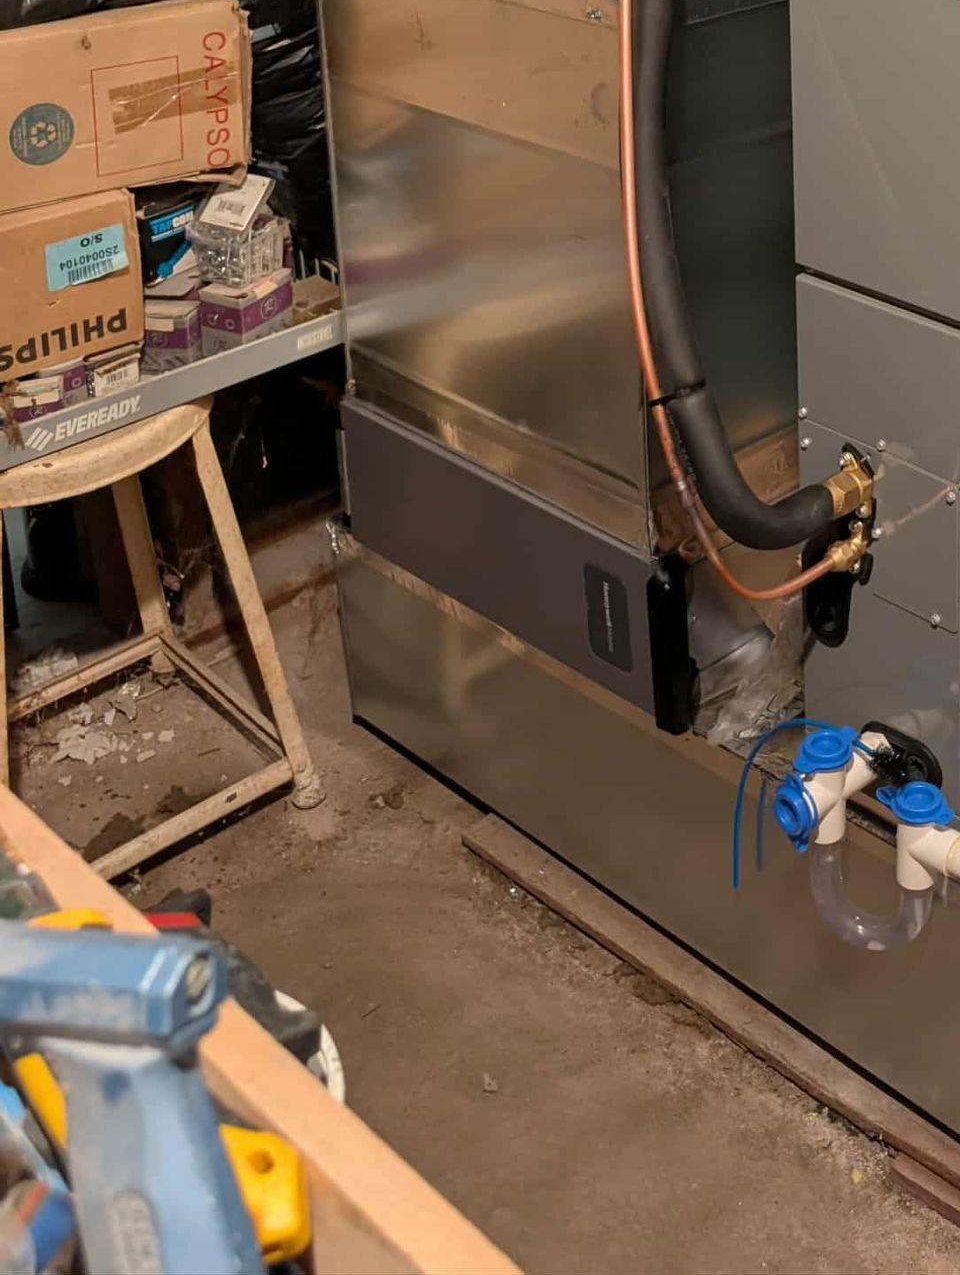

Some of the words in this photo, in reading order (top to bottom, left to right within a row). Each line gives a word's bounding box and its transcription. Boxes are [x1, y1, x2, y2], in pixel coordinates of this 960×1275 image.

[201, 30, 231, 168] CALYPSO
[59, 244, 120, 272] 2S0040104
[80, 233, 103, 247] S/O
[0, 307, 128, 372] PHILIPS
[54, 395, 139, 444] EVEREADY
